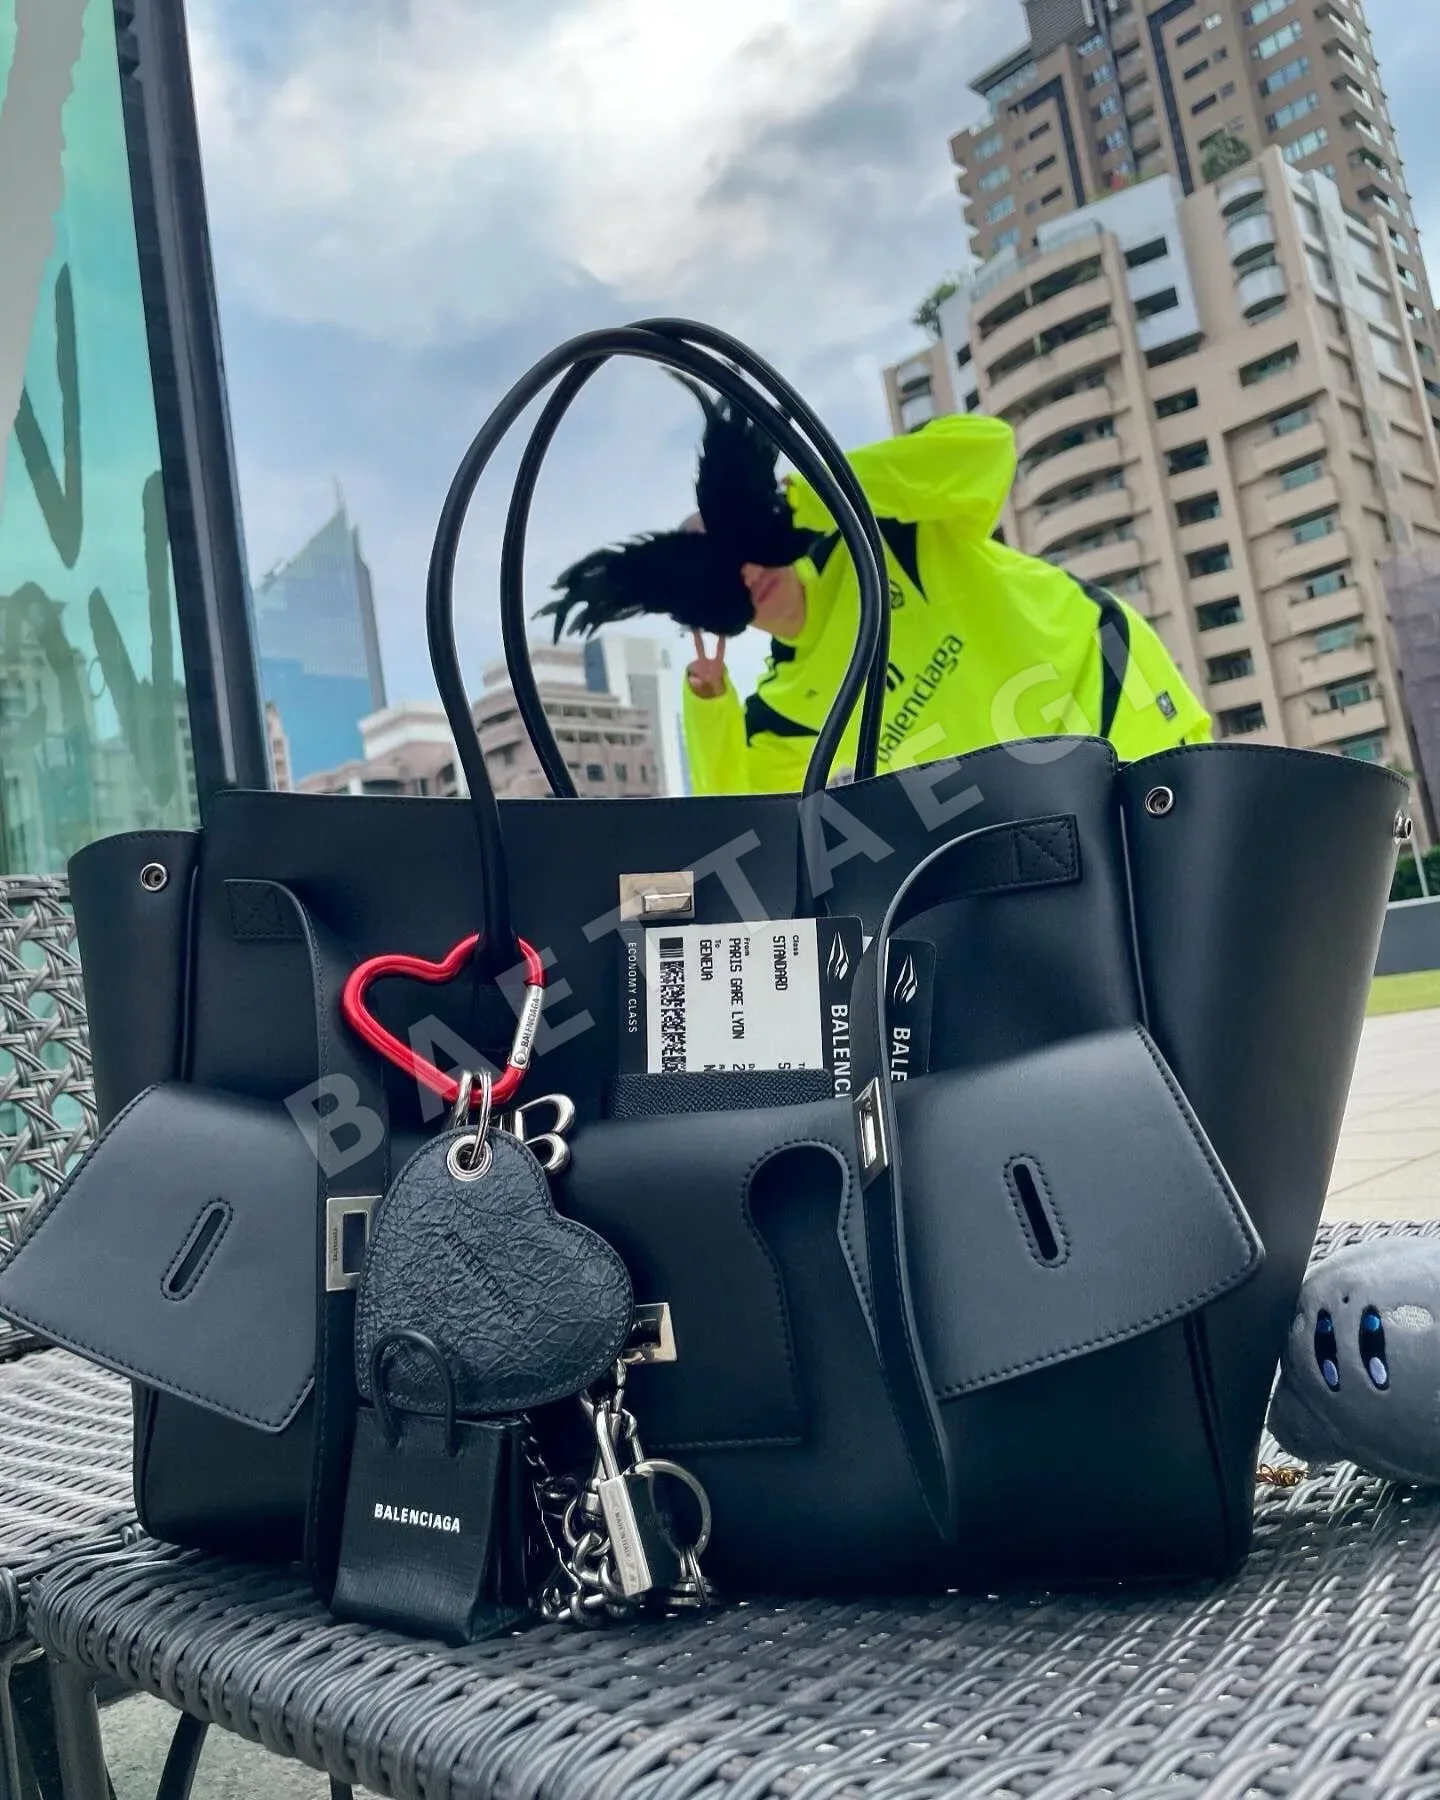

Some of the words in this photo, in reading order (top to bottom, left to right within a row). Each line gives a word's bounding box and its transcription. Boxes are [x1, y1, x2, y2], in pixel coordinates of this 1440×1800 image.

[700, 939, 714, 981] GENEVA
[729, 938, 743, 972] PARIS
[743, 937, 751, 957] From
[792, 934, 800, 956] Class
[628, 942, 637, 995] ECONOMY
[772, 935, 788, 991] STANDARD
[730, 977, 744, 1006] GARE
[520, 998, 540, 1048] BALENCIAGA
[628, 998, 638, 1033] CLASS
[732, 1011, 745, 1040] LYON
[374, 1503, 461, 1533] BALENCIAGA
